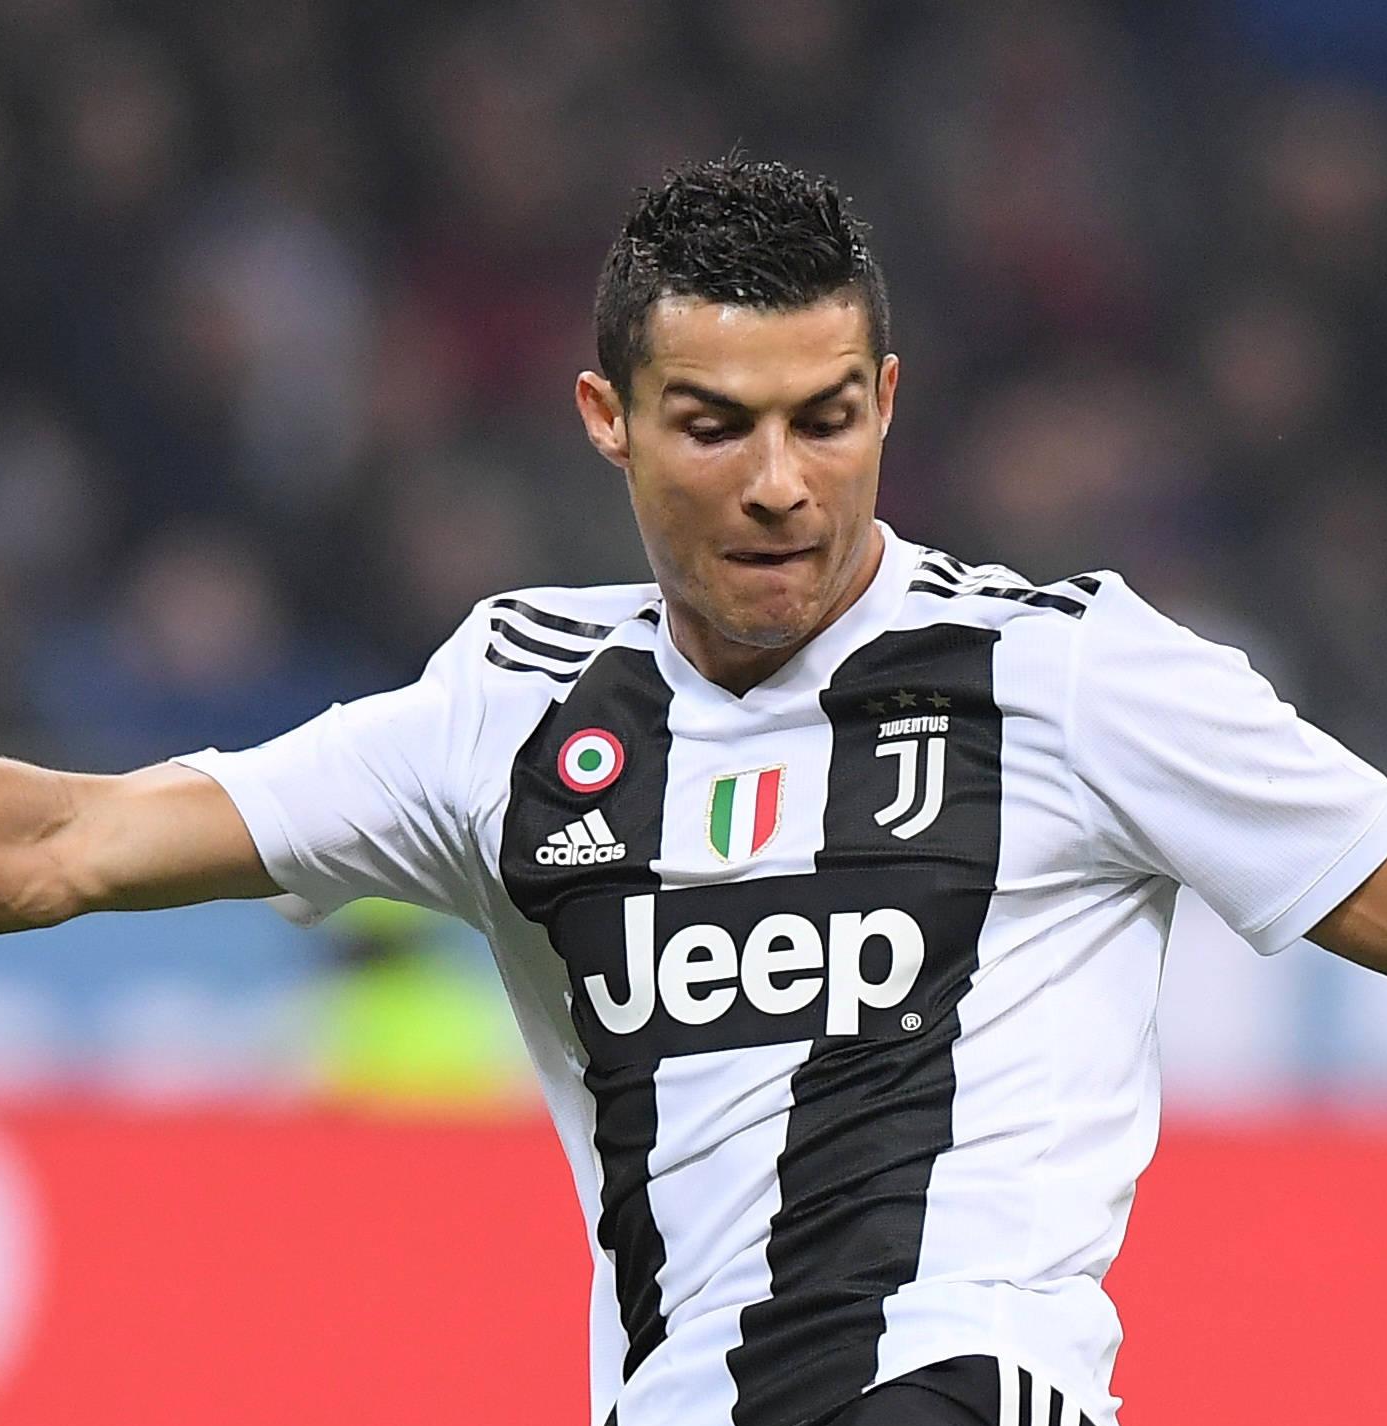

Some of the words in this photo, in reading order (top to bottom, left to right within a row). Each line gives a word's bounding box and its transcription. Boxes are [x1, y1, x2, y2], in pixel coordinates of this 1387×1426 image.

[878, 715, 950, 739] JUVENTUS
[535, 842, 627, 866] adidas
[583, 893, 925, 1036] Jeep
